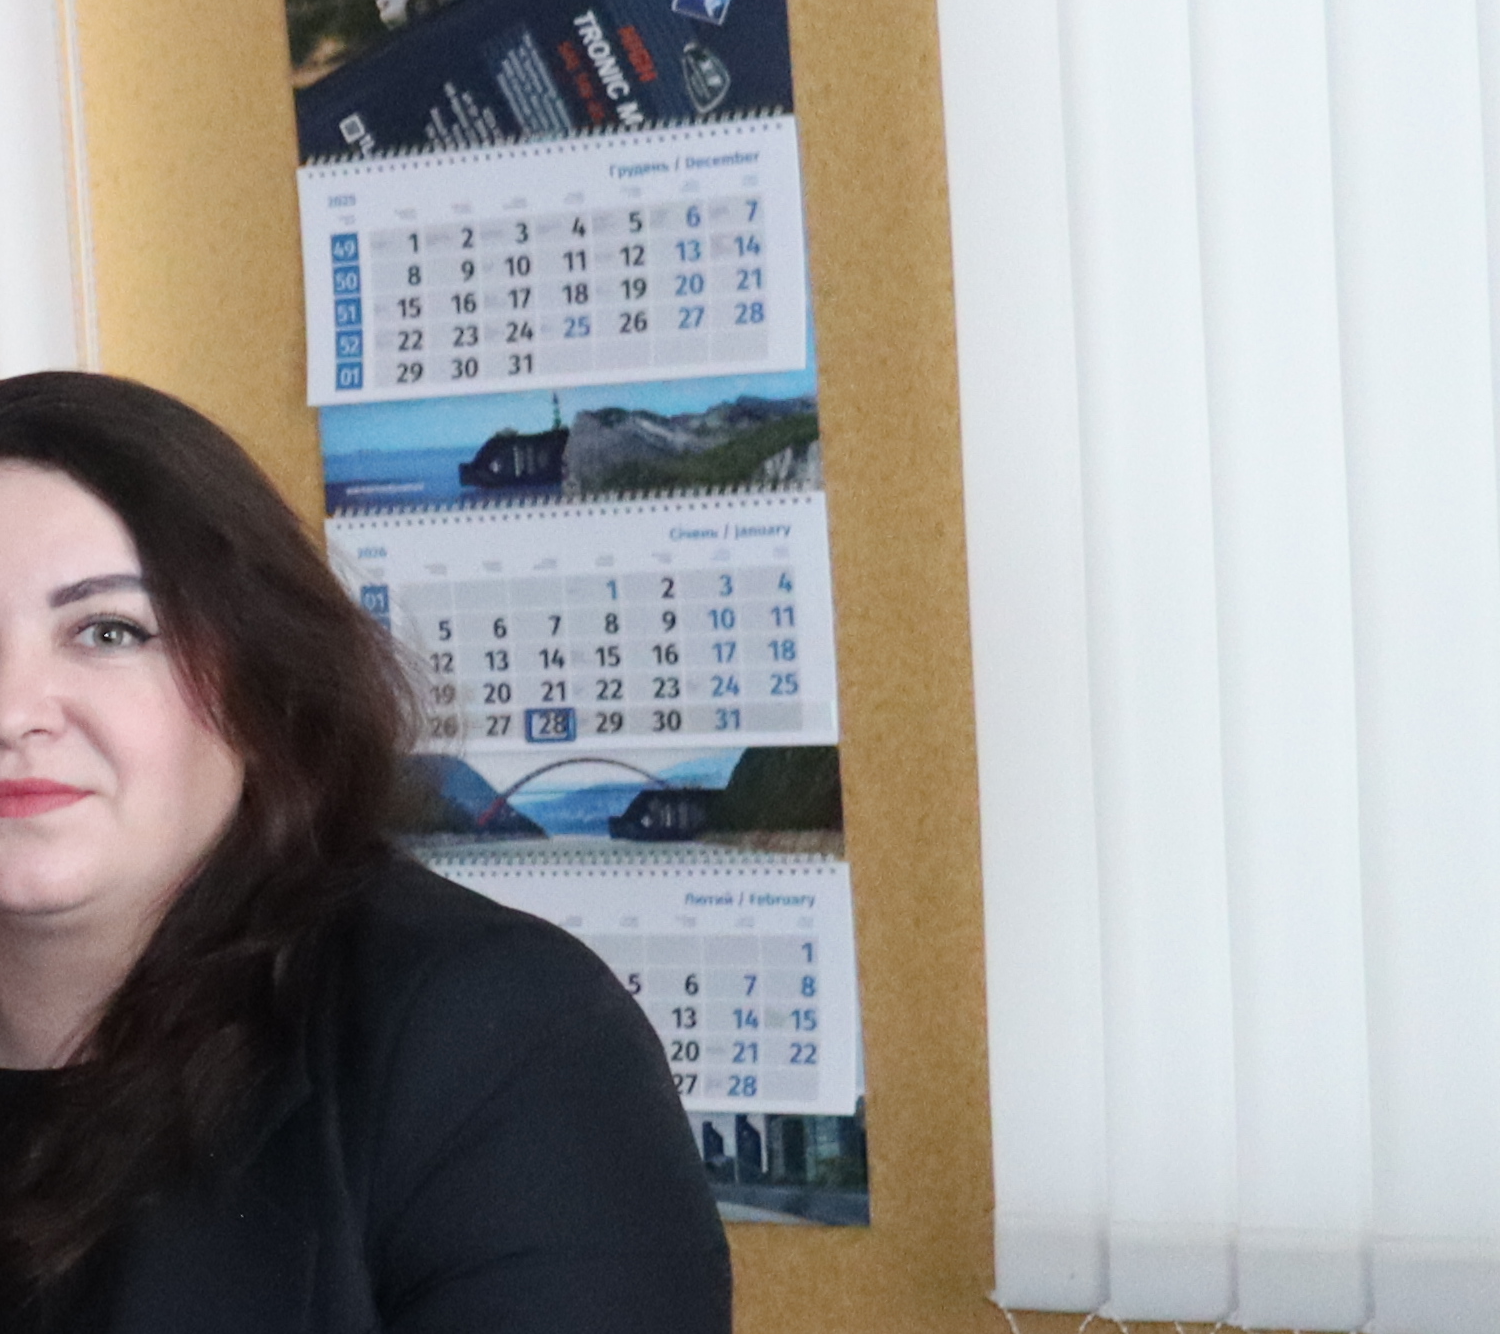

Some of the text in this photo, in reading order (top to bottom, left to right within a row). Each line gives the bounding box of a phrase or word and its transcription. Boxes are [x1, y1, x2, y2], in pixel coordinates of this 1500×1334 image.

[573, 9, 631, 100] TRONIC
[686, 152, 759, 168] December
[333, 199, 758, 256] 49 1 2 3 4 5 6 7
[335, 235, 761, 290] 50 8 9 10 11 12 13 14
[337, 268, 762, 322] 51 15 16 17 18 19 20 21
[340, 302, 765, 353] 52 22 23 24 25 26 27 28
[340, 354, 533, 386] 01 29 30 31
[607, 580, 617, 600] 1
[661, 577, 675, 598] 2
[720, 575, 732, 596] 3
[779, 573, 792, 593] 4
[439, 606, 794, 641] 5 6 7 8 9 10 11
[430, 639, 796, 673] 12 13 14 15 16 17 18
[430, 673, 798, 705] 19 20 21 22 23 24 25
[486, 715, 511, 736] 27
[540, 711, 567, 734] 28
[596, 712, 623, 733] 29
[653, 710, 682, 732] 30
[716, 708, 741, 730] 31
[749, 892, 815, 907] February
[802, 942, 813, 963] 1
[628, 973, 815, 997] 5 6 7 8
[672, 1007, 817, 1031] 13 14 15
[671, 1041, 817, 1064] 20 21 22
[673, 1074, 757, 1097] 27 28
